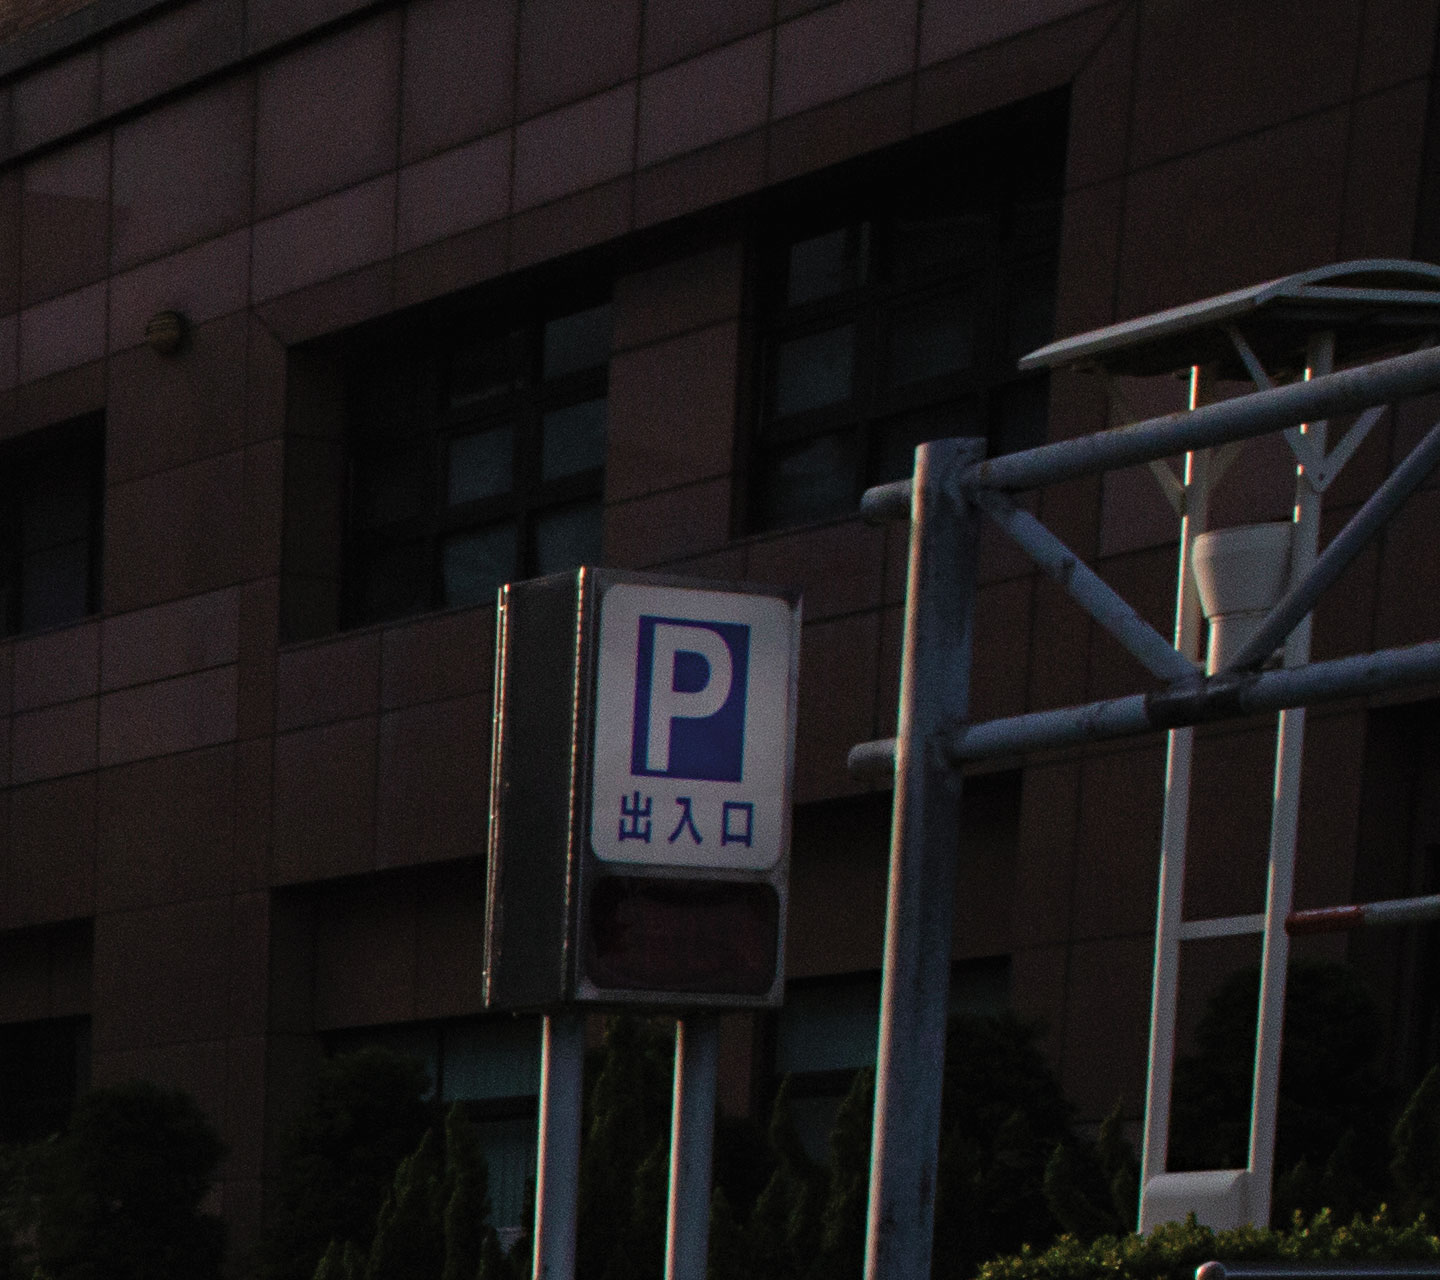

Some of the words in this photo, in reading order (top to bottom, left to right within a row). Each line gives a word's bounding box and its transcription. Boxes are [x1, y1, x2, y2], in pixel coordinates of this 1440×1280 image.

[645, 623, 734, 774] P
[617, 791, 755, 848] 出入口
